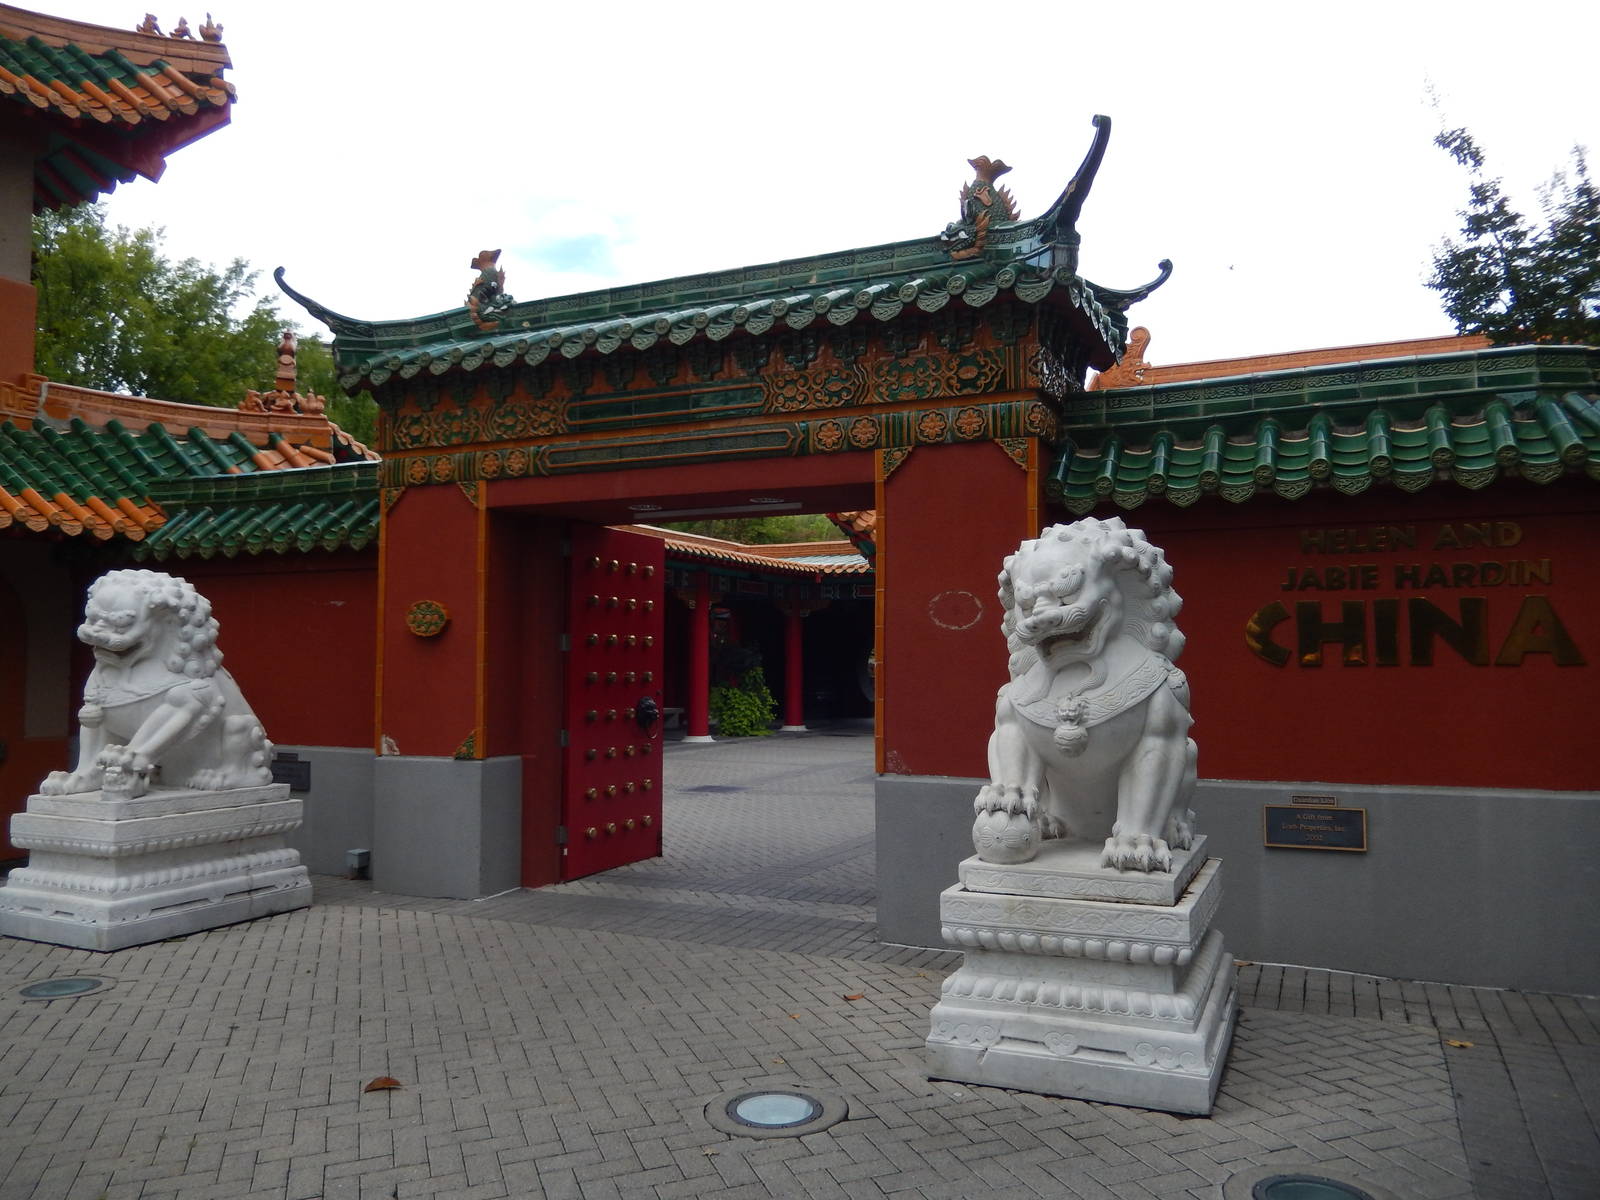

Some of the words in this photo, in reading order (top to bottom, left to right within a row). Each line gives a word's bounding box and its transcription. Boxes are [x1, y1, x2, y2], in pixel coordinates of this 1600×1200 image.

[1299, 525, 1416, 555] HELEN
[1431, 521, 1523, 550] AND
[1280, 564, 1379, 592] JABIE
[1395, 558, 1552, 590] HARDIN
[1245, 594, 1588, 668] CHINA
